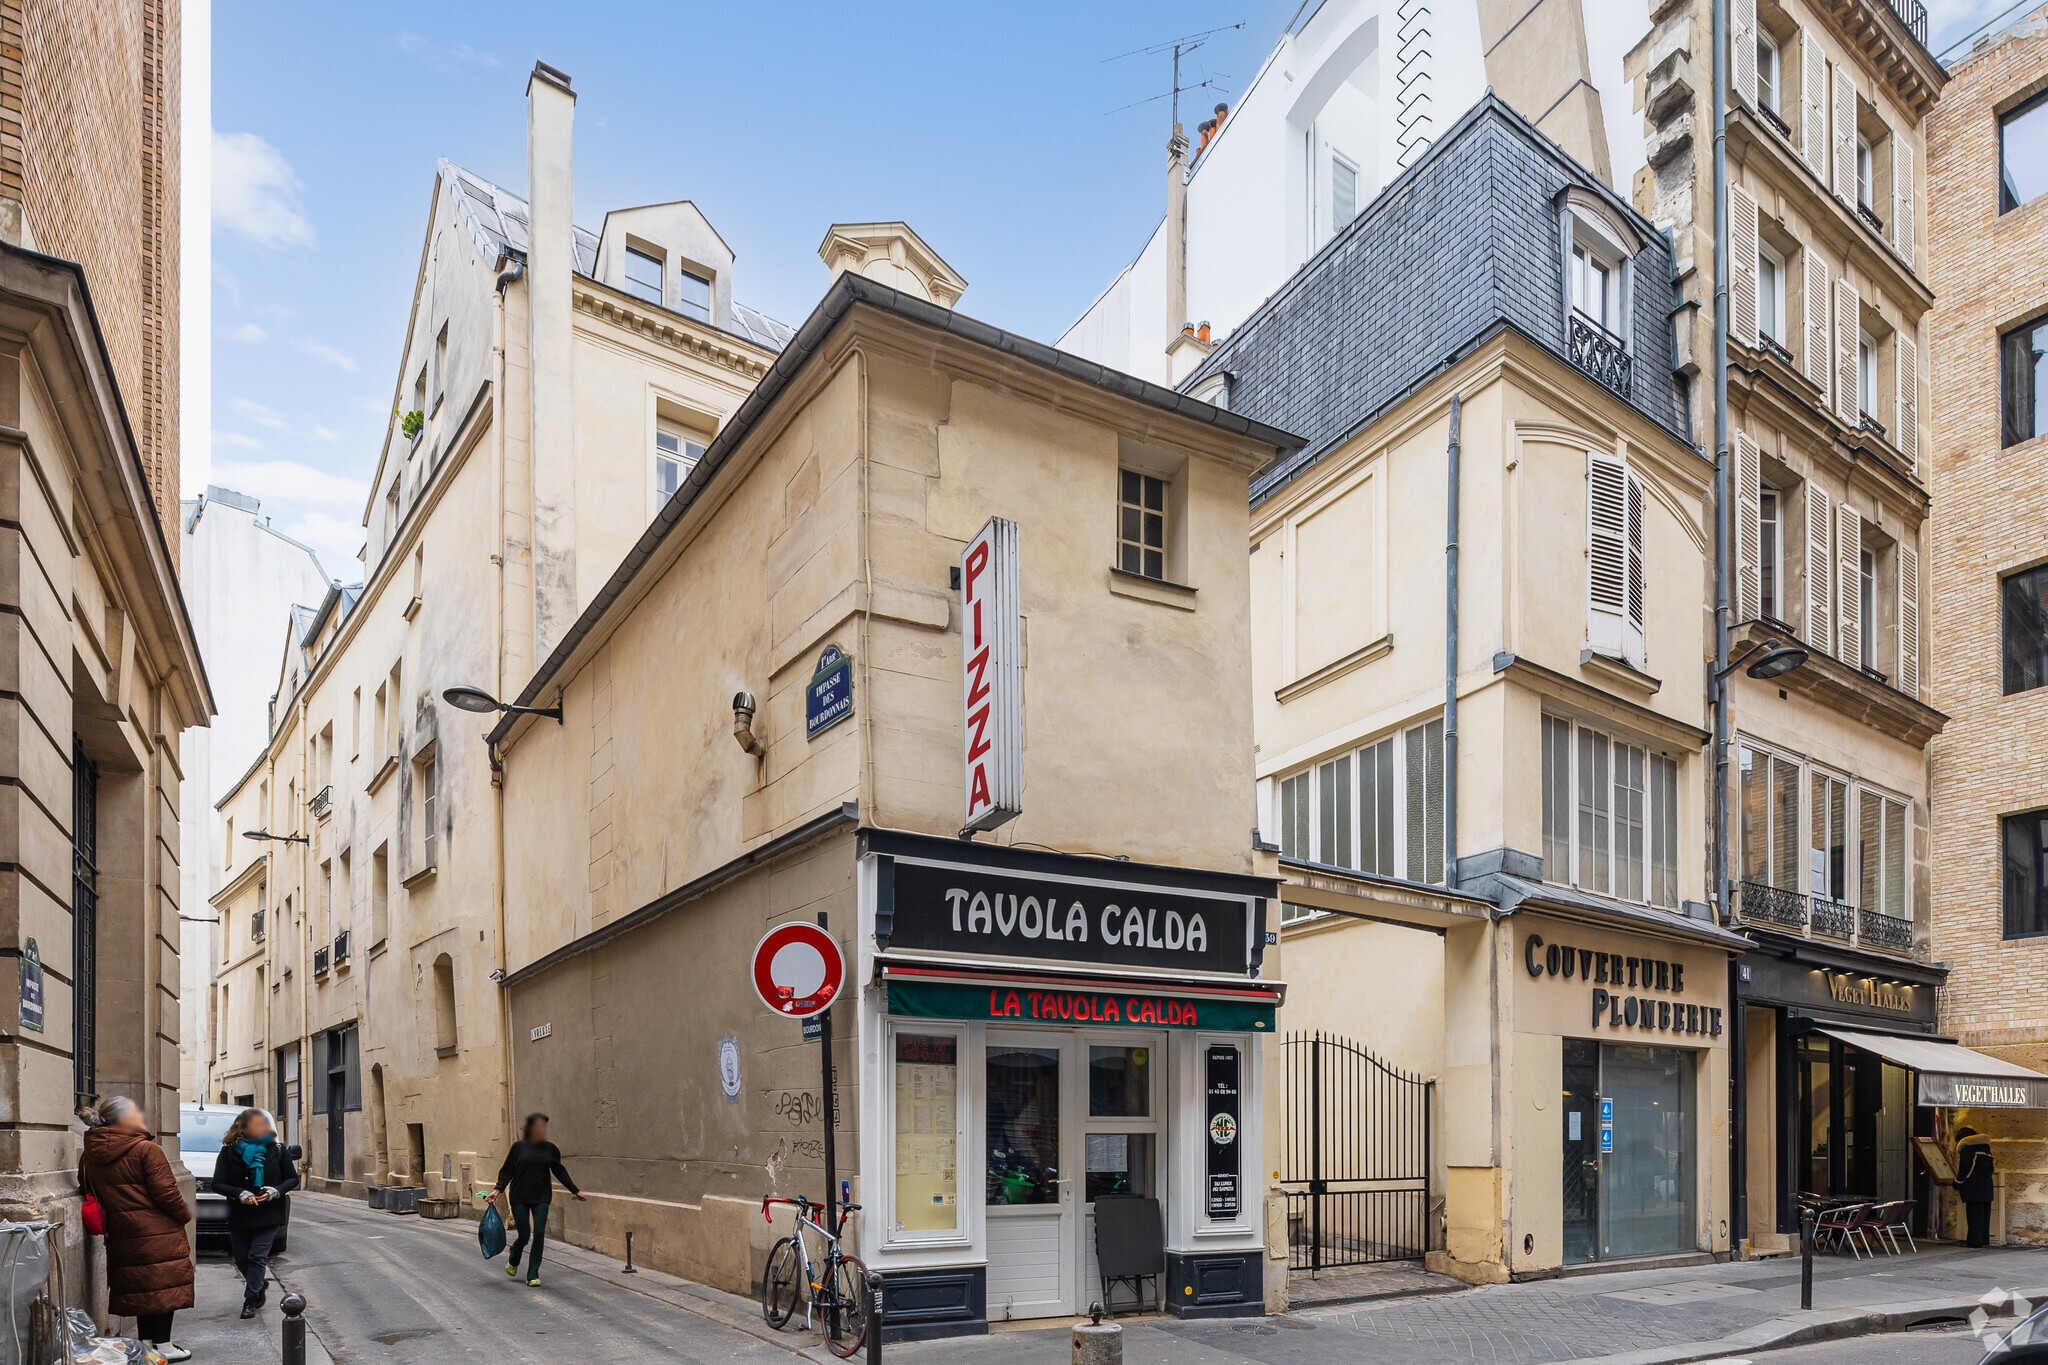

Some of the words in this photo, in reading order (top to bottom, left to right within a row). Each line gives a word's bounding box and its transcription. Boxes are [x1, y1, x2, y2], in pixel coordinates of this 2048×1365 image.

[816, 672, 841, 697] IMPASSE
[965, 541, 991, 817] PIZZA
[809, 696, 850, 729] BOURDONNAIS
[822, 691, 835, 707] DES
[945, 887, 1088, 943] TAVOLA
[1101, 903, 1207, 952] CALDA
[1265, 933, 1275, 943] 39
[1525, 934, 1684, 992] COUVERTURE
[1742, 967, 1750, 980] 41
[990, 990, 1021, 1017] LA
[1027, 991, 1120, 1022] TAVOLA
[1126, 997, 1197, 1026] CALDA
[1592, 988, 1722, 1036] PLOMBERIE
[803, 1024, 821, 1034] BOURDON
[1955, 1084, 2026, 1105] VEGET'HALLES
